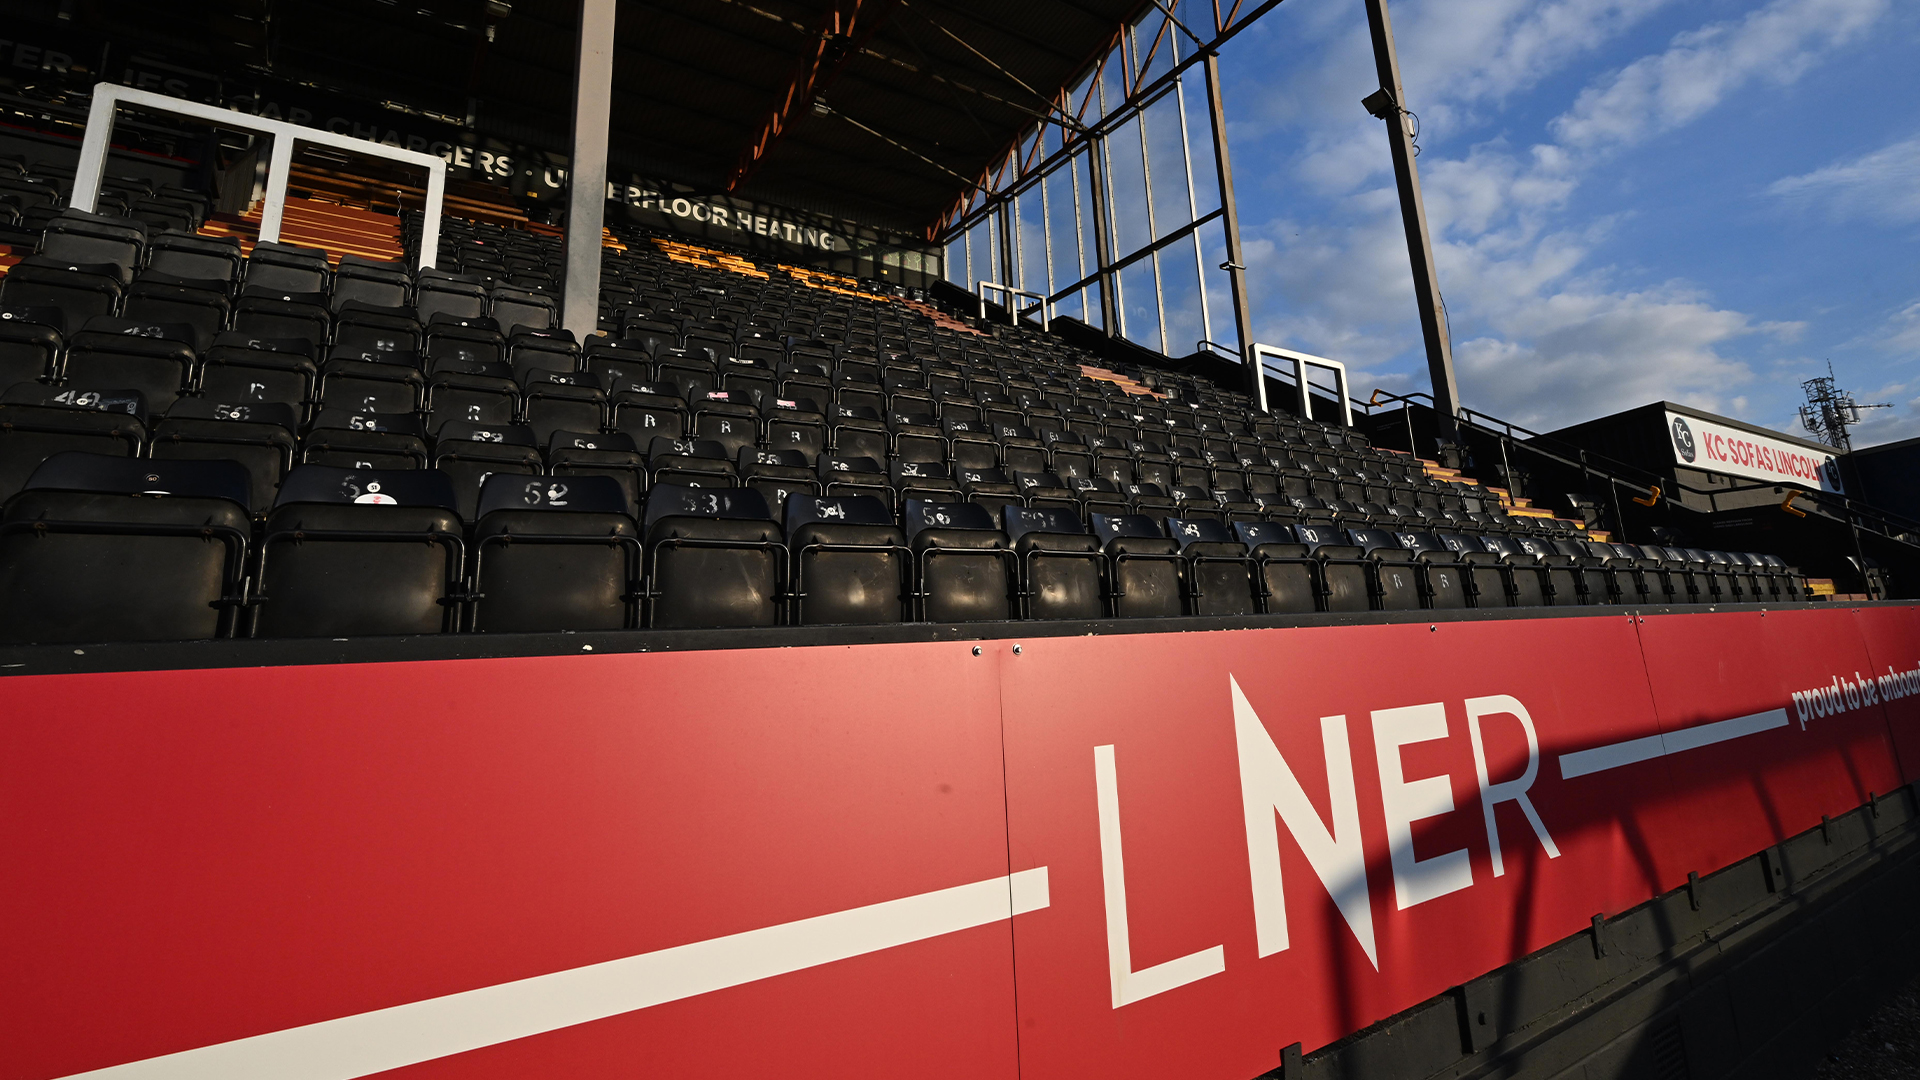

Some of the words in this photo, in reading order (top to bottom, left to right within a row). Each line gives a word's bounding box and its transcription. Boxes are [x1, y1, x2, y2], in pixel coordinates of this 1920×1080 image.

[545, 166, 728, 227] UERFLOOR
[736, 212, 835, 251] HEATING
[1703, 431, 1728, 462] KC
[1727, 437, 1774, 472] SOFAS
[1772, 448, 1825, 482] LINCOLN
[524, 481, 568, 506] 52
[1791, 675, 1846, 732] proud
[1840, 676, 1860, 711] to
[1855, 671, 1879, 707] be
[1878, 660, 1920, 702] onboar
[1093, 671, 1562, 1010] LNER
